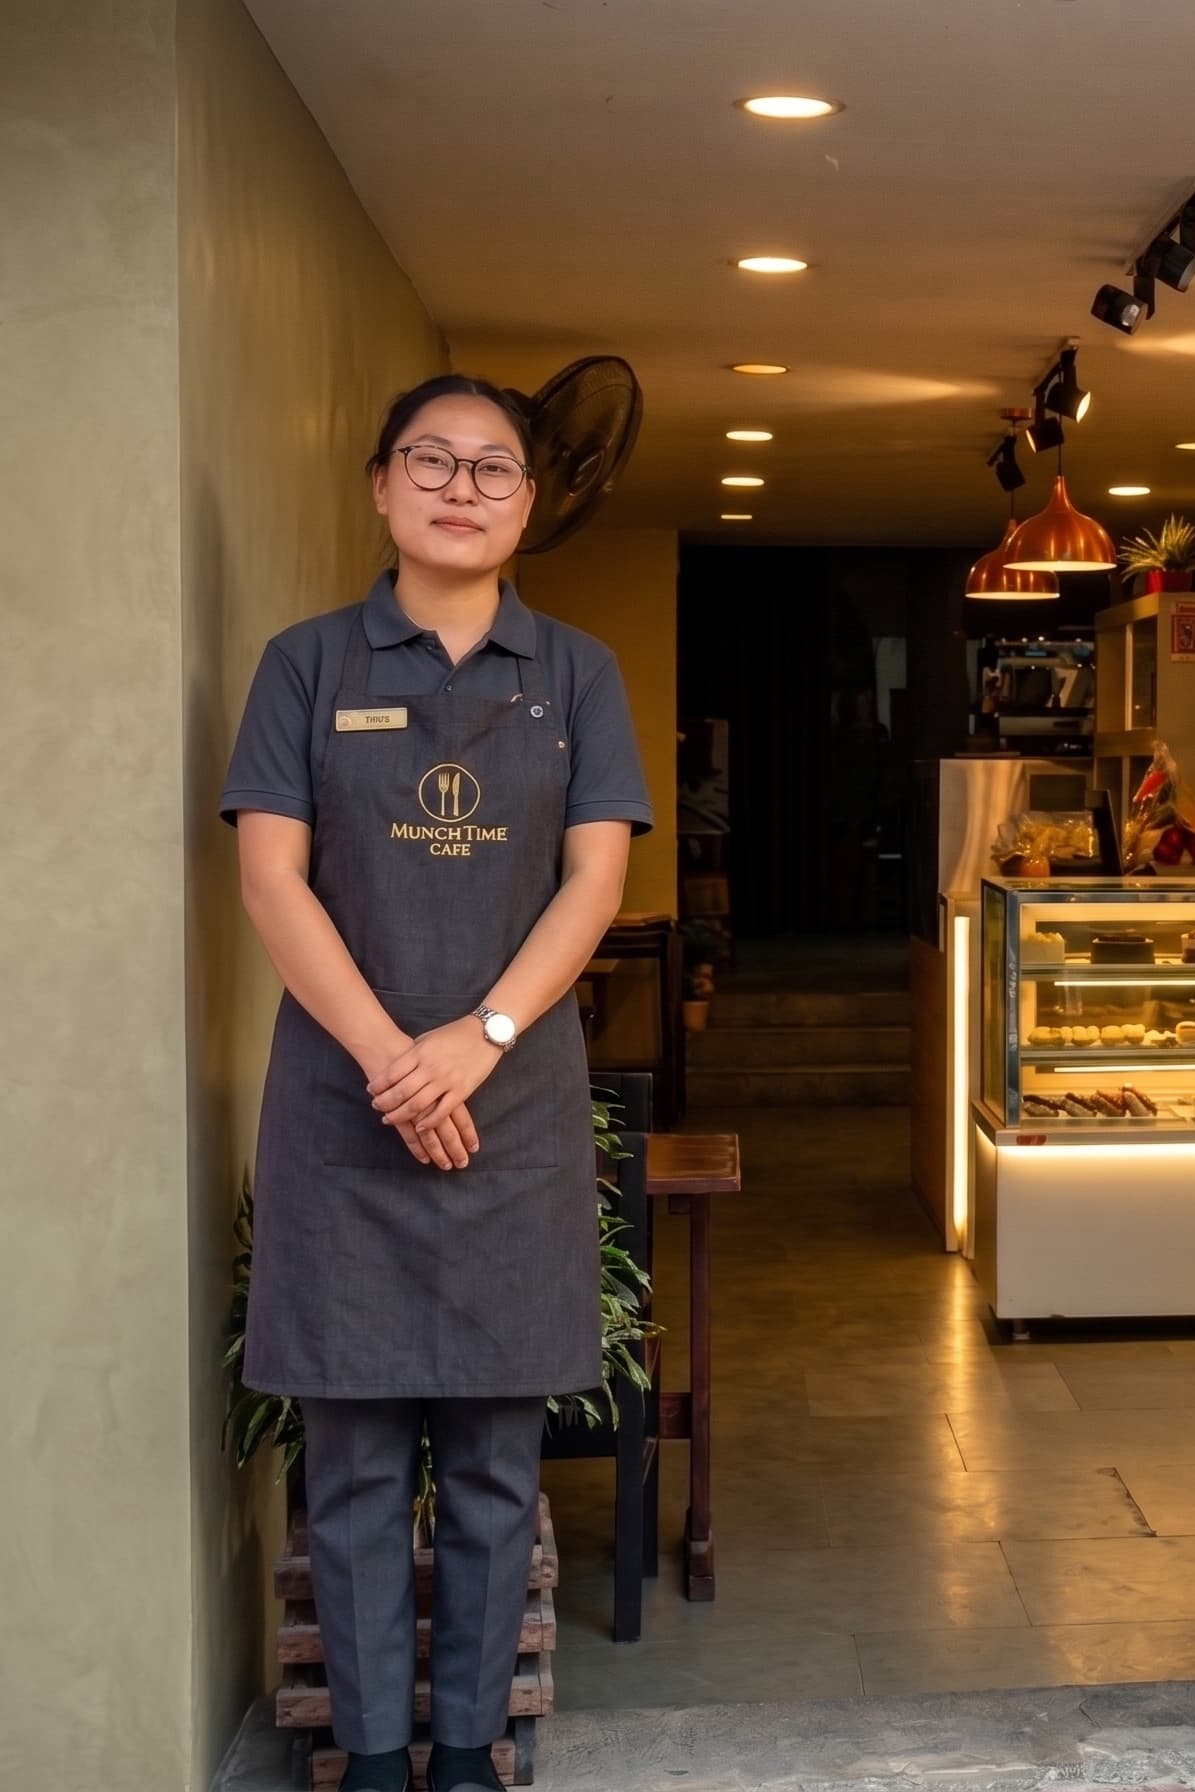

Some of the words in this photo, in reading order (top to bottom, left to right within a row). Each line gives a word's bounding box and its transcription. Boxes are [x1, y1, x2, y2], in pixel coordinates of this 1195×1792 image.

[390, 822, 461, 841] MUNCH
[463, 825, 508, 841] TIME
[430, 843, 471, 856] CAFE
